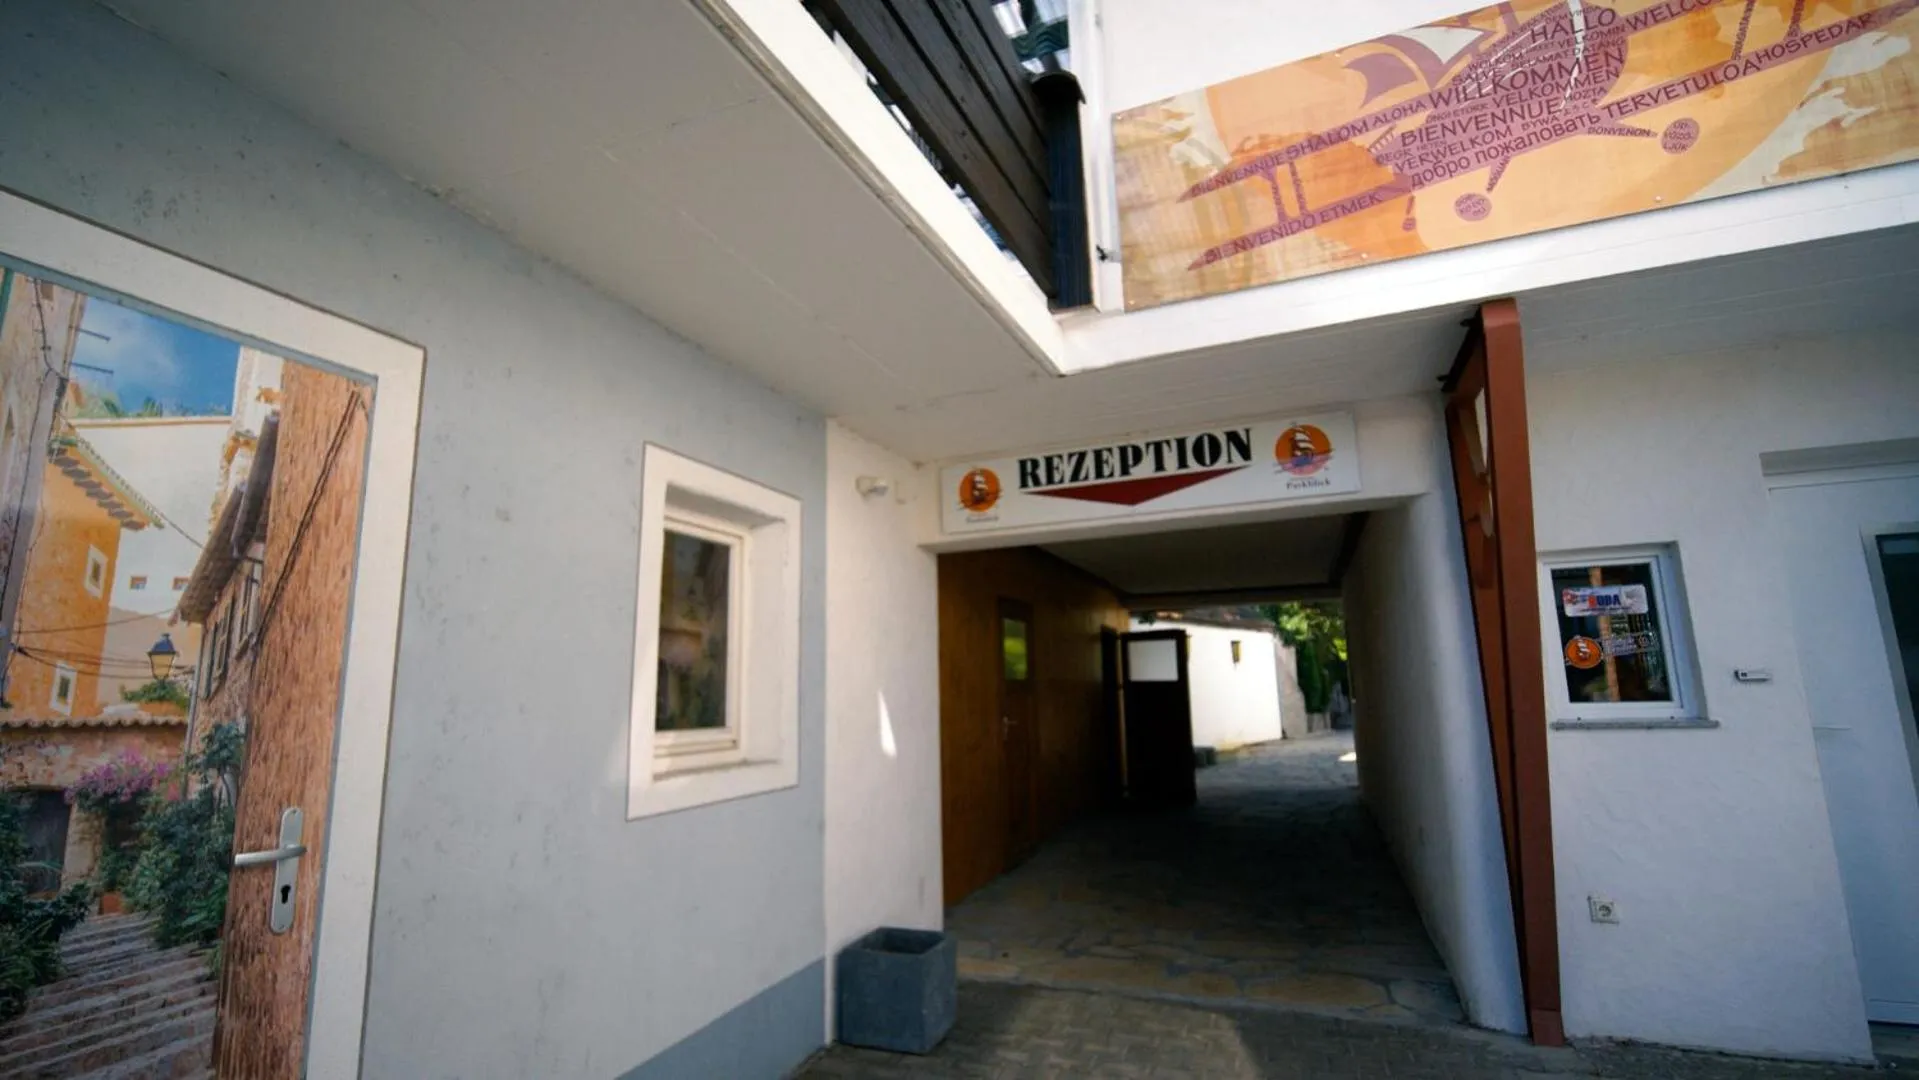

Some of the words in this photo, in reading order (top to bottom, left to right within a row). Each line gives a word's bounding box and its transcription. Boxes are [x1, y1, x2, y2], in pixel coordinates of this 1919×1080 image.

[1531, 8, 1616, 44] HALLO
[1755, 12, 1876, 63] HOSPEDAR
[1285, 118, 1370, 160] SHALOM
[1372, 99, 1427, 128] ALOHA
[1428, 46, 1626, 109] WILLKOMMEN
[1492, 67, 1620, 108] VELKOMMEN
[1602, 57, 1761, 120] TERVETULOA
[1395, 126, 1512, 173] VERWELKOM
[1400, 101, 1560, 147] BIENVENNUE
[1411, 156, 1471, 191] добро
[1475, 112, 1601, 166] пожаловать
[1204, 212, 1318, 264] BIENVENIDO
[1320, 191, 1385, 224] ETMEK
[1018, 427, 1253, 490] REZEPTION
